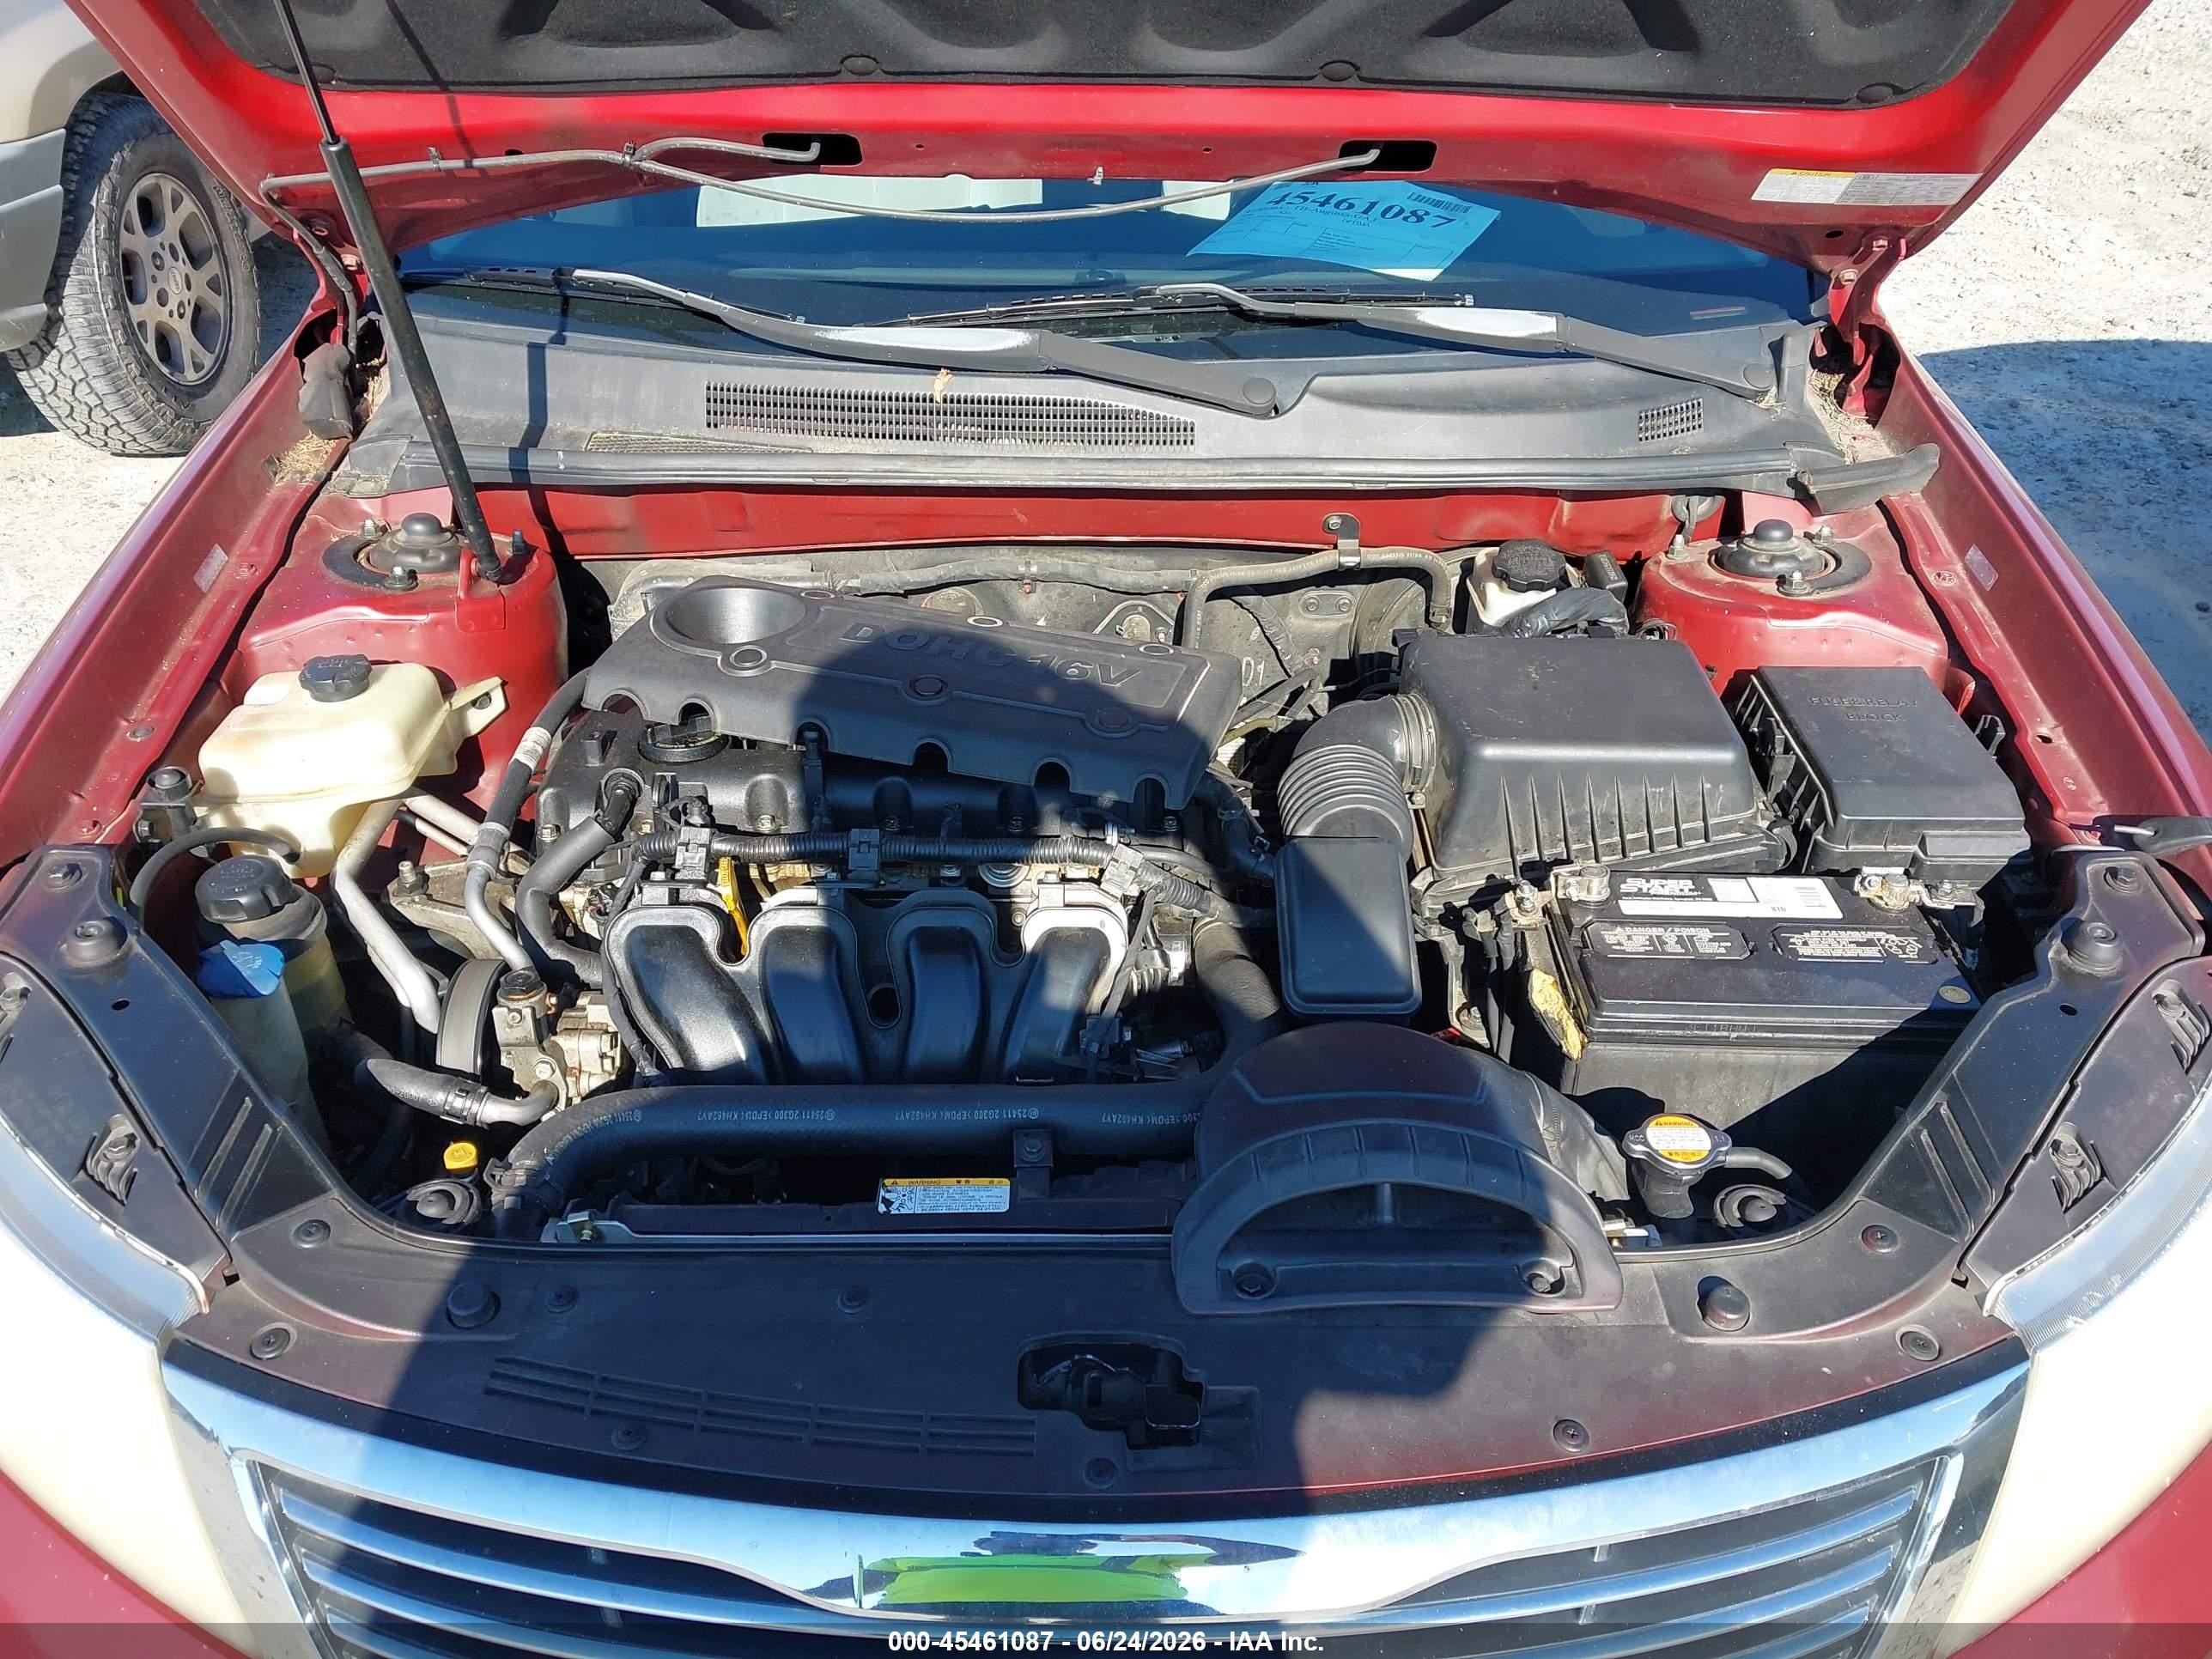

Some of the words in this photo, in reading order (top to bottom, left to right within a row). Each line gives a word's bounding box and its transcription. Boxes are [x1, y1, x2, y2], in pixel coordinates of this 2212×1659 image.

[1267, 191, 1457, 228] 45461087
[839, 623, 1019, 667] DOHC
[1027, 654, 1142, 687] 16V
[1845, 712, 1905, 722] BLOCK
[1626, 878, 1694, 886] SUPER
[1620, 884, 1695, 894] START
[775, 1109, 799, 1120] 2G300
[974, 1109, 1000, 1119] 2G300
[1002, 1109, 1028, 1119] 25411
